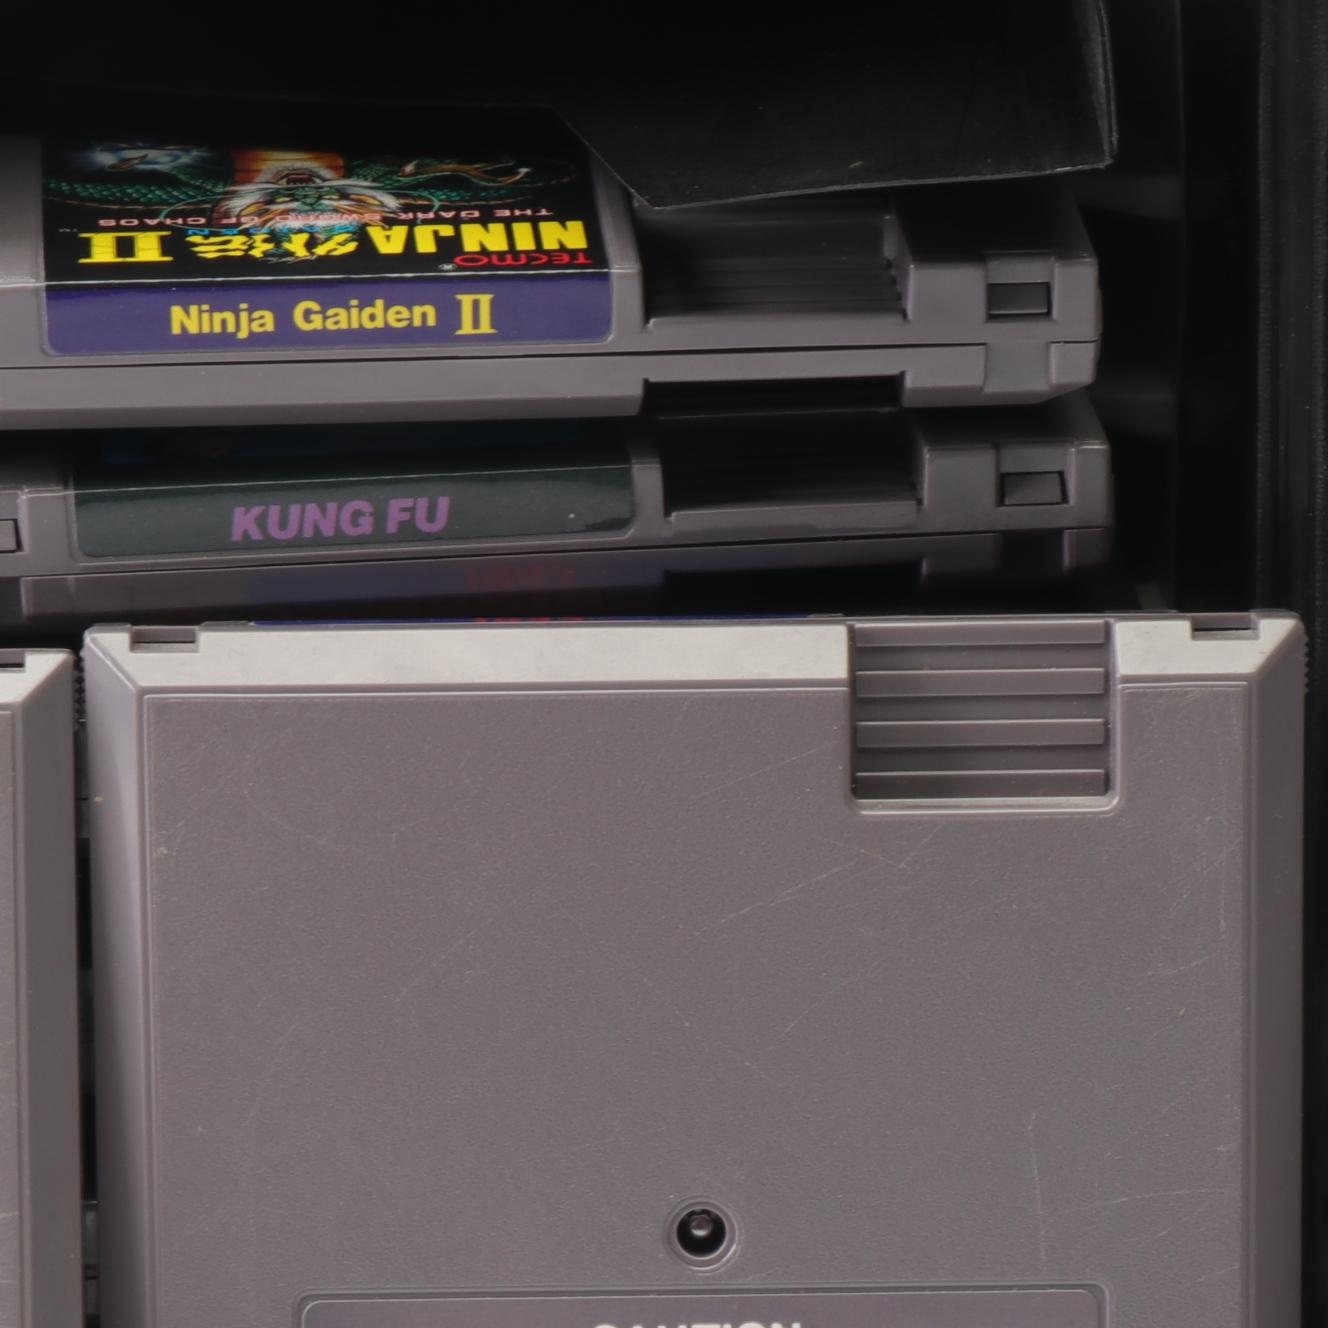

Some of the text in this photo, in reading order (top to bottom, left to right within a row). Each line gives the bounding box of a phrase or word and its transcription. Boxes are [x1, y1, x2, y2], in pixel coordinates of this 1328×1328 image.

[98, 217, 207, 226] CHAOS
[397, 210, 479, 221] DARK
[494, 208, 553, 217] THE
[365, 220, 588, 255] NINJA
[170, 303, 275, 340] Ninja
[292, 298, 437, 332] Gaiden
[230, 496, 451, 542] KUNG FU
